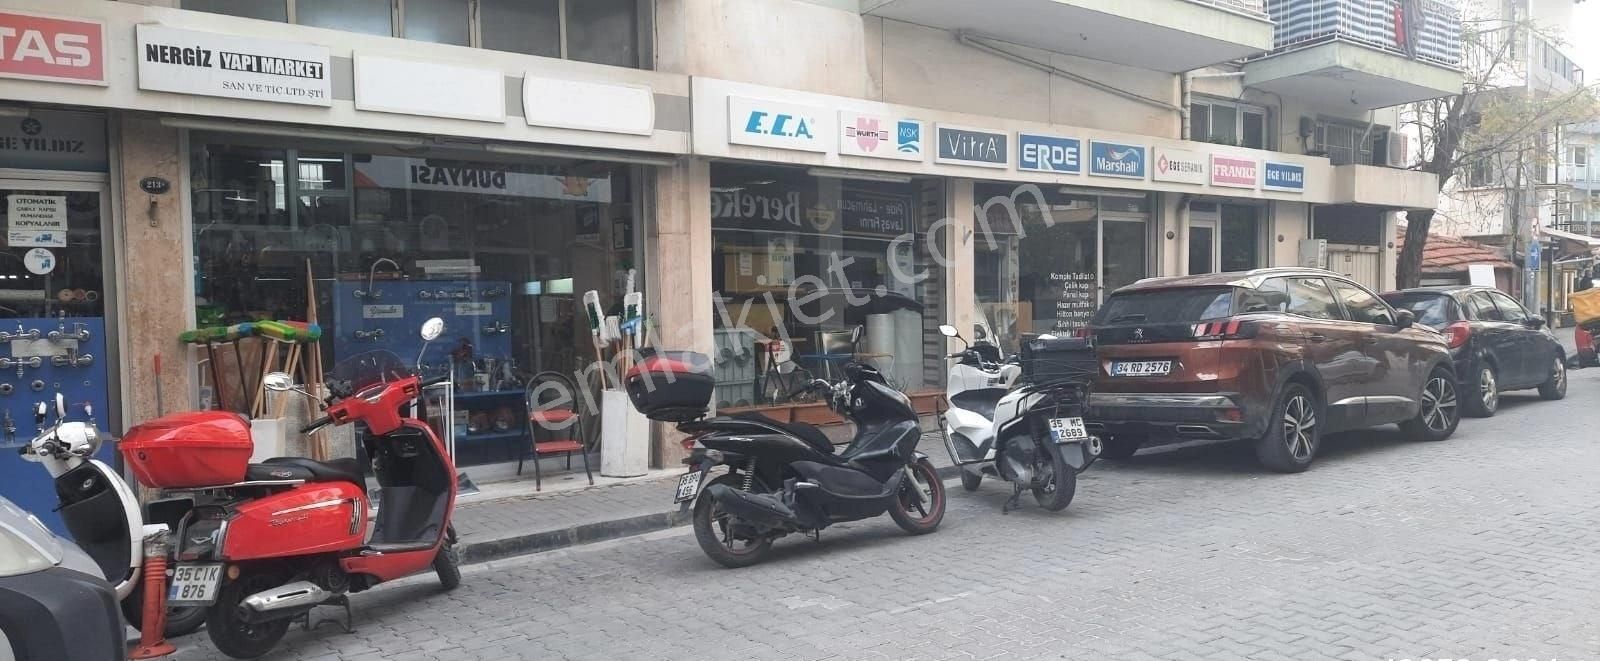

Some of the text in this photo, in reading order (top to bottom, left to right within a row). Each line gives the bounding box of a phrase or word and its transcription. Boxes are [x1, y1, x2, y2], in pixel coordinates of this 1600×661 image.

[146, 43, 323, 79] NERGİZ YAPI MARKET
[222, 81, 244, 92] SAN
[248, 82, 263, 93] VE
[899, 126, 919, 138] NSK
[948, 134, 999, 159] VitrA
[1023, 143, 1077, 170] ERDE
[1096, 156, 1138, 174] Marshall
[1214, 164, 1256, 180] FRANKE
[1267, 170, 1302, 183] EGE YILDIZ
[1117, 362, 1169, 373] 34 RD 2576
[1050, 420, 1063, 428] 35
[1060, 429, 1083, 438] 2689
[176, 567, 218, 581] 35 CIK
[182, 585, 206, 599] 876
